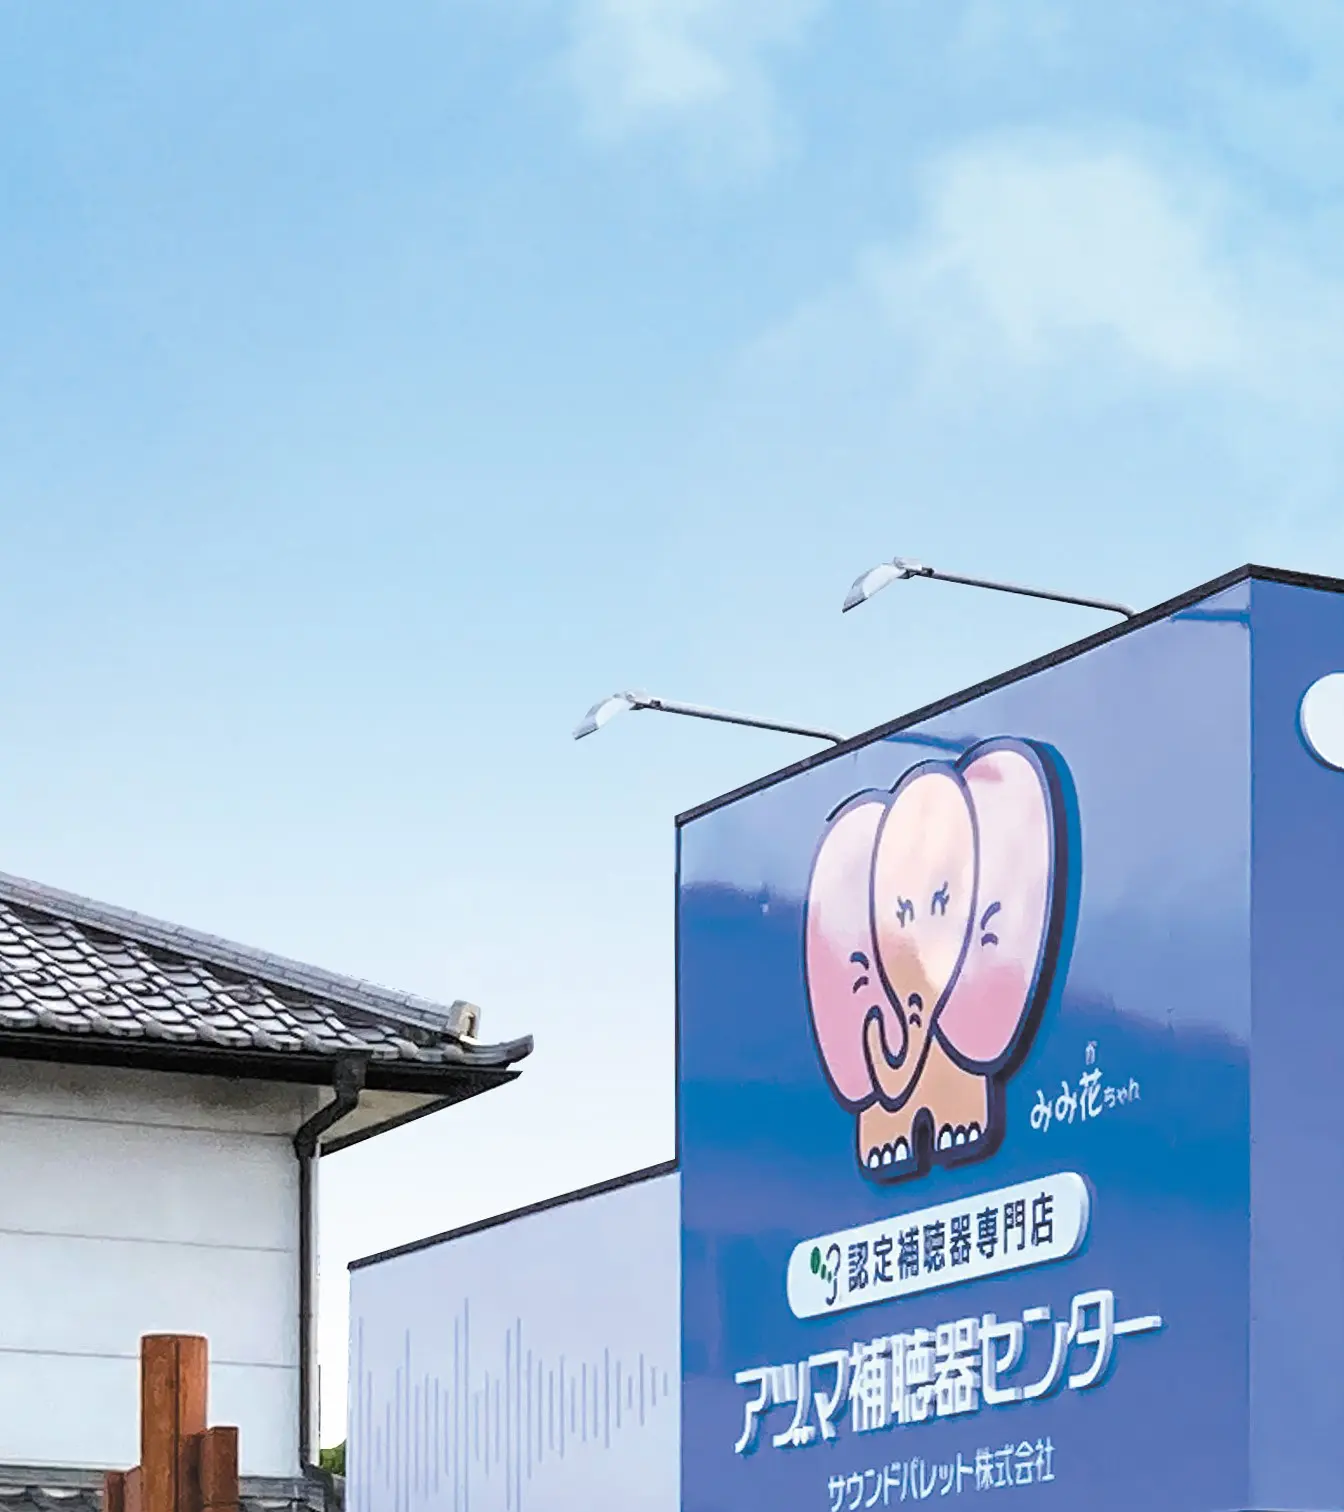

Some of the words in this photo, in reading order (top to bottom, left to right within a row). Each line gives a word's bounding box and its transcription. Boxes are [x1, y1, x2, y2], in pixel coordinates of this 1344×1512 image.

[1029, 1067, 1141, 1133] みみ花ちゃん
[847, 1191, 1054, 1293] 認定補聴器専門店
